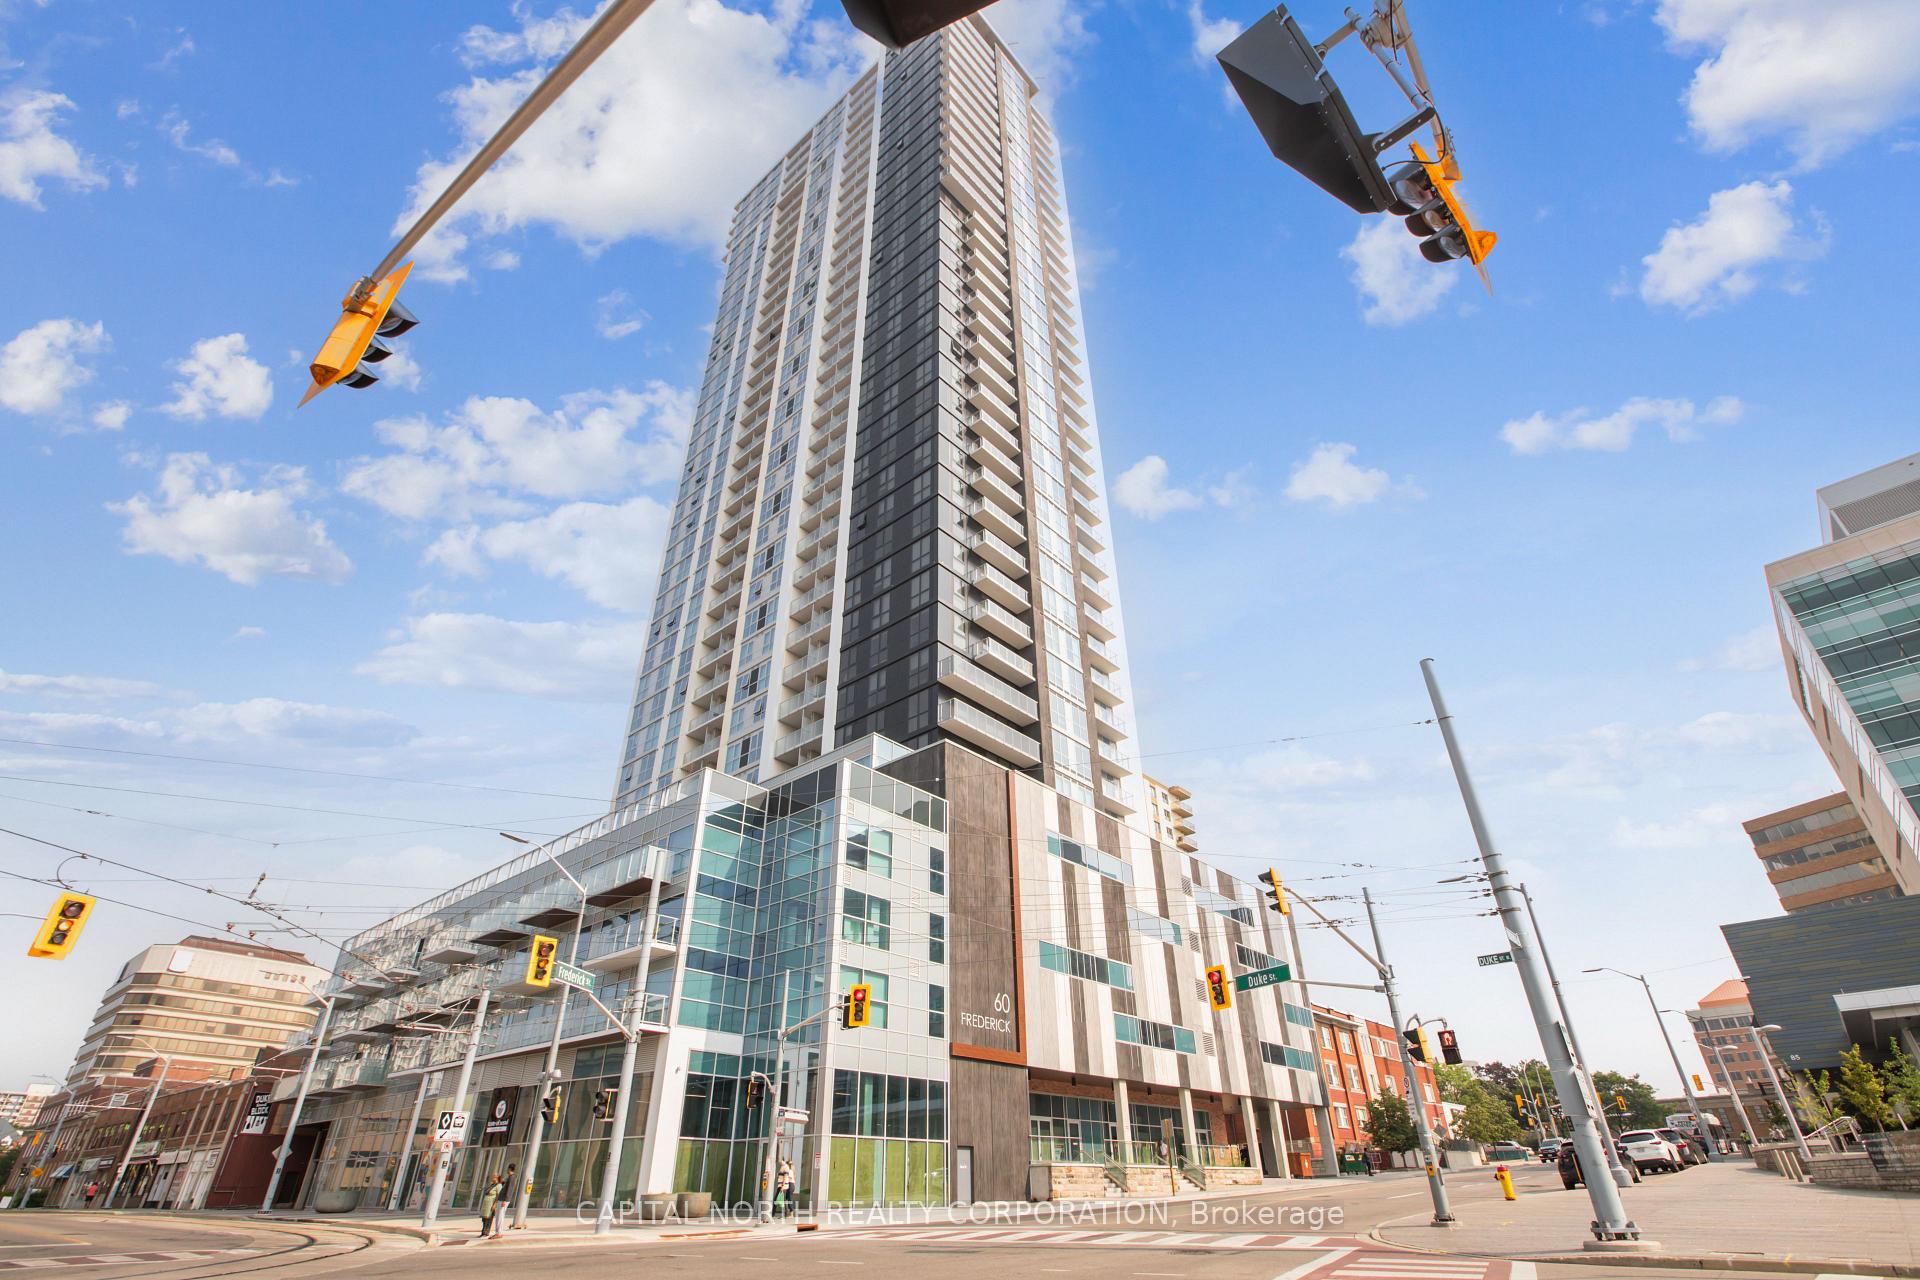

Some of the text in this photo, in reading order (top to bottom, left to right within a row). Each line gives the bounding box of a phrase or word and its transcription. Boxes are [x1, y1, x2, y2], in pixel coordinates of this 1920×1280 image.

[1479, 955, 1499, 965] DUKE
[558, 966, 585, 986] Frederick
[1248, 973, 1268, 988] Duke
[994, 992, 1011, 1013] 60
[961, 1012, 1011, 1033] FREDERICK
[251, 1106, 269, 1115] BLOCK
